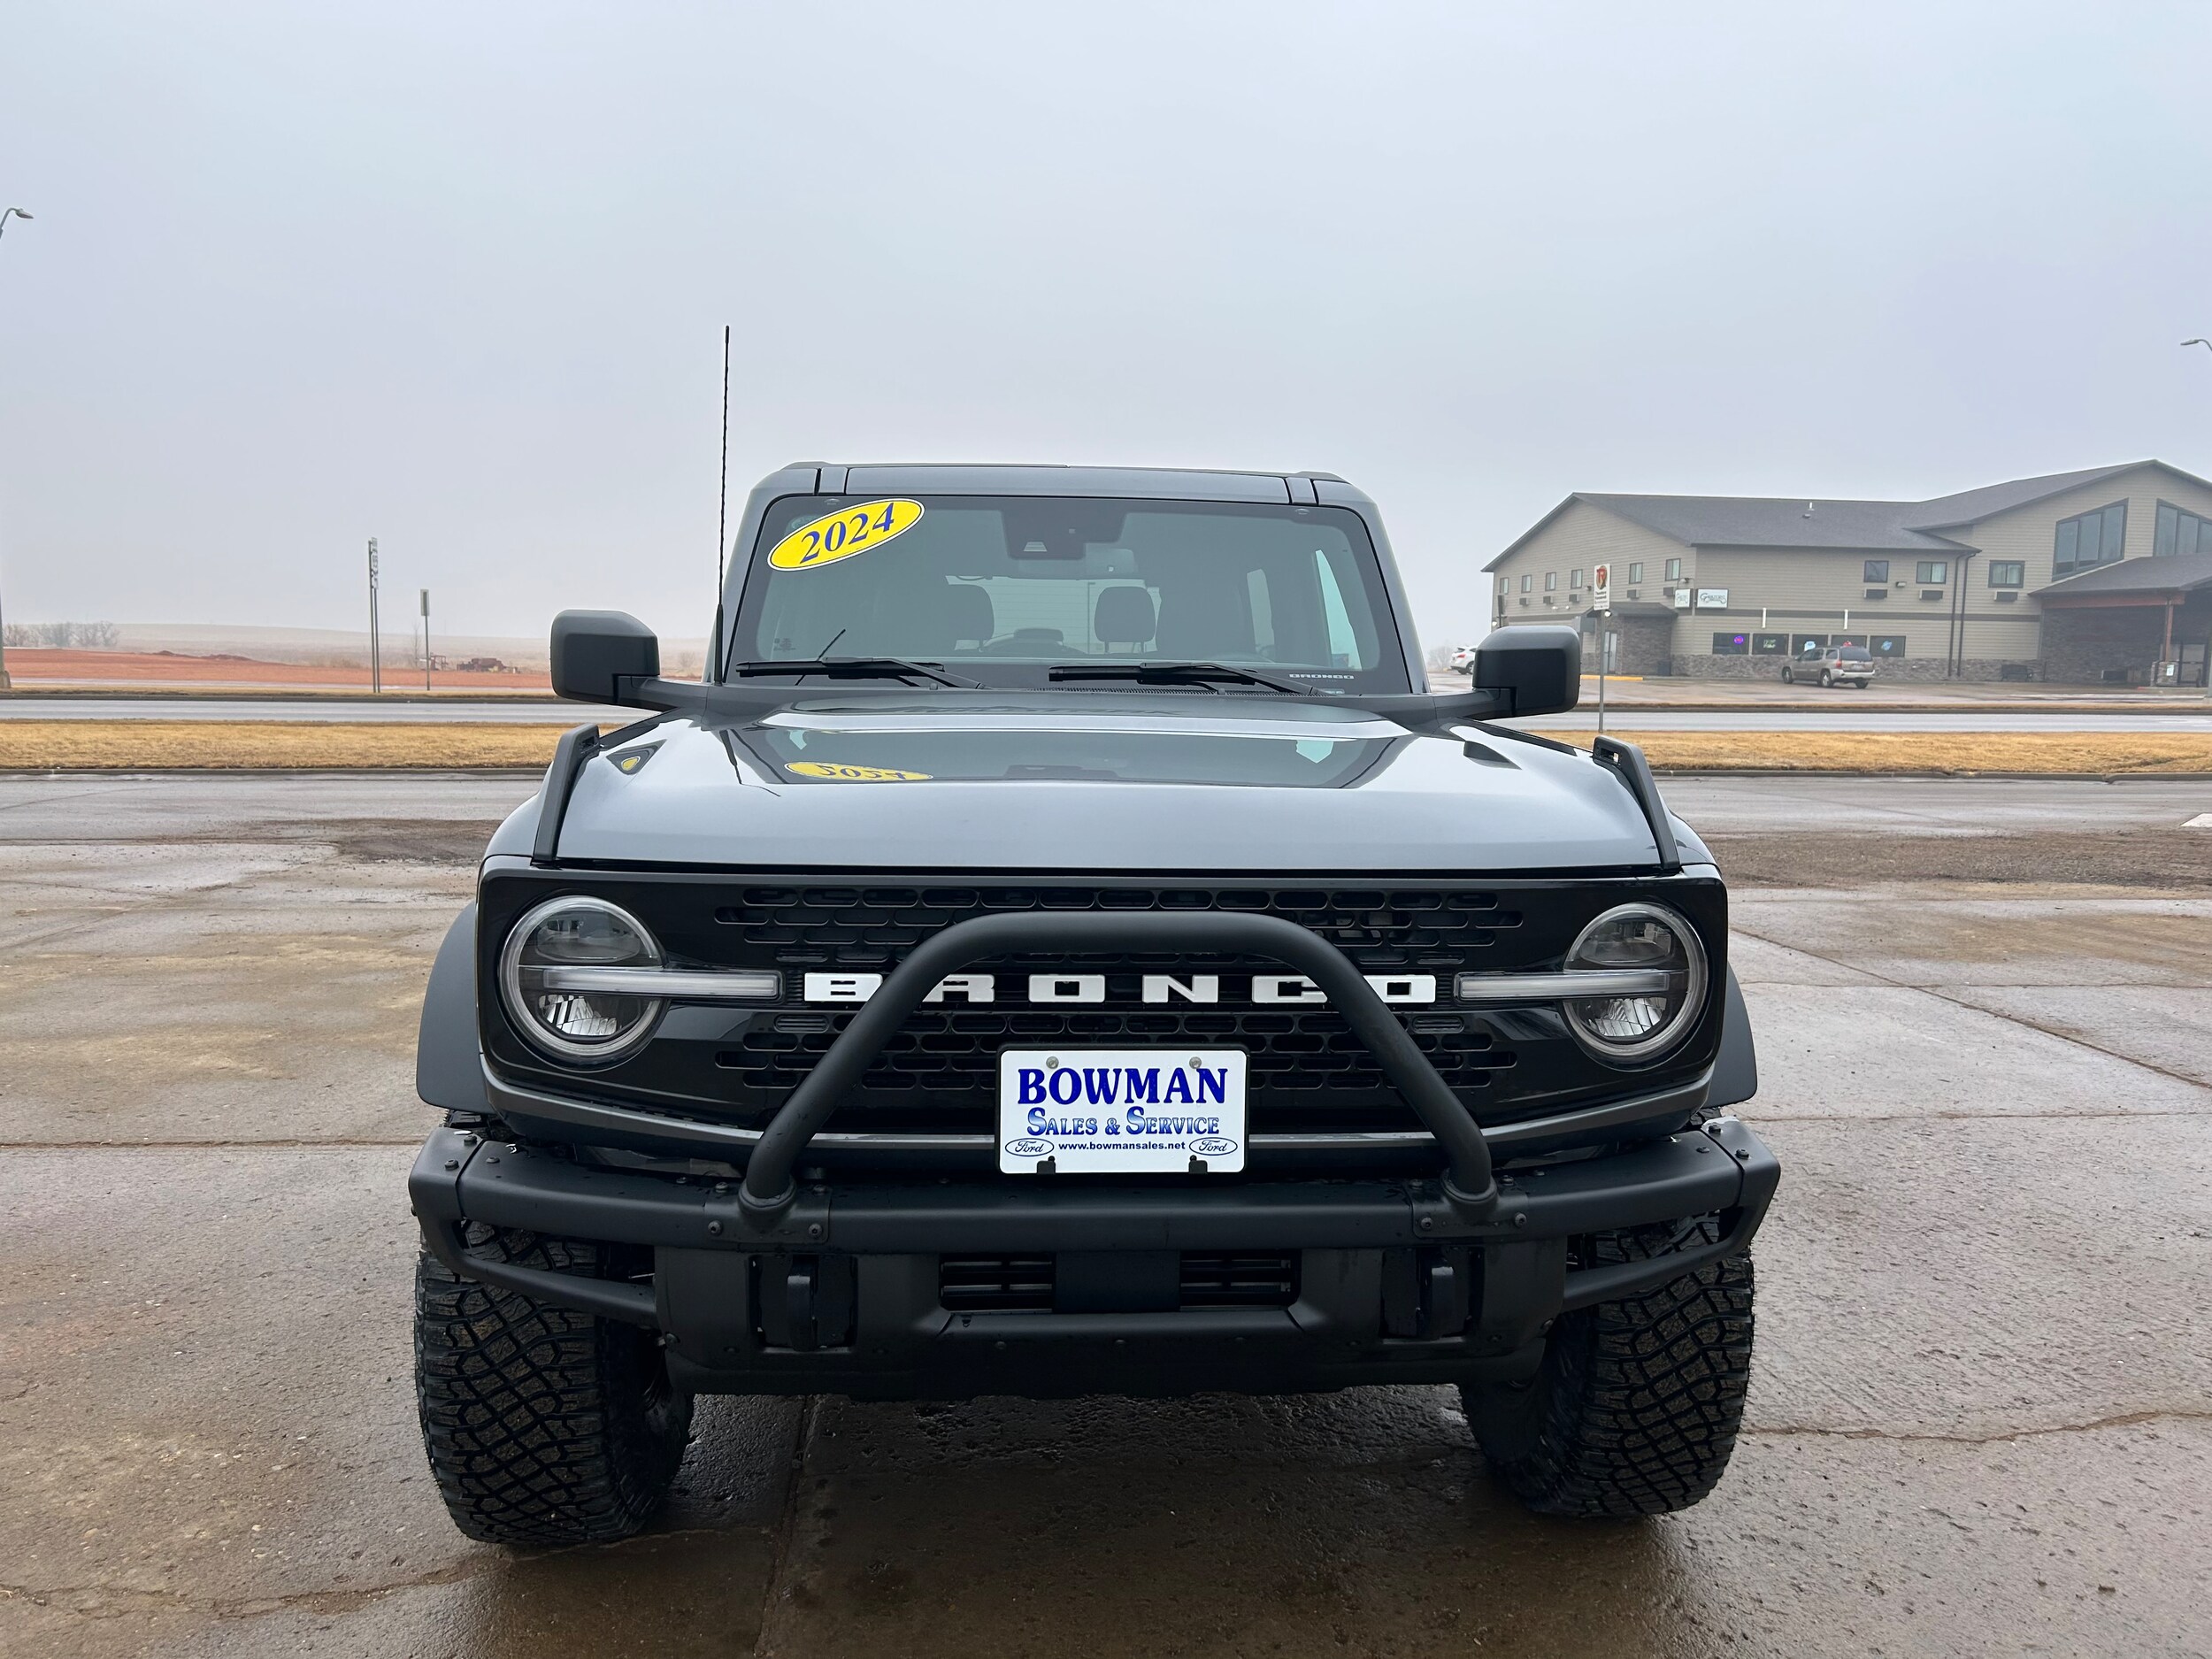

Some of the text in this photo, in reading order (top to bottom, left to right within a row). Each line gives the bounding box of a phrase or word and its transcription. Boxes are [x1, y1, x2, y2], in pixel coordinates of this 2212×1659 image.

[800, 502, 894, 565] 2024
[804, 972, 1437, 1003] BRONCO
[1018, 1067, 1228, 1104] BOWMAN
[1104, 1118, 1121, 1135] &
[1014, 1140, 1044, 1153] Ford
[1058, 1141, 1186, 1150] www.bowmansales.net
[1198, 1140, 1228, 1152] Ford
